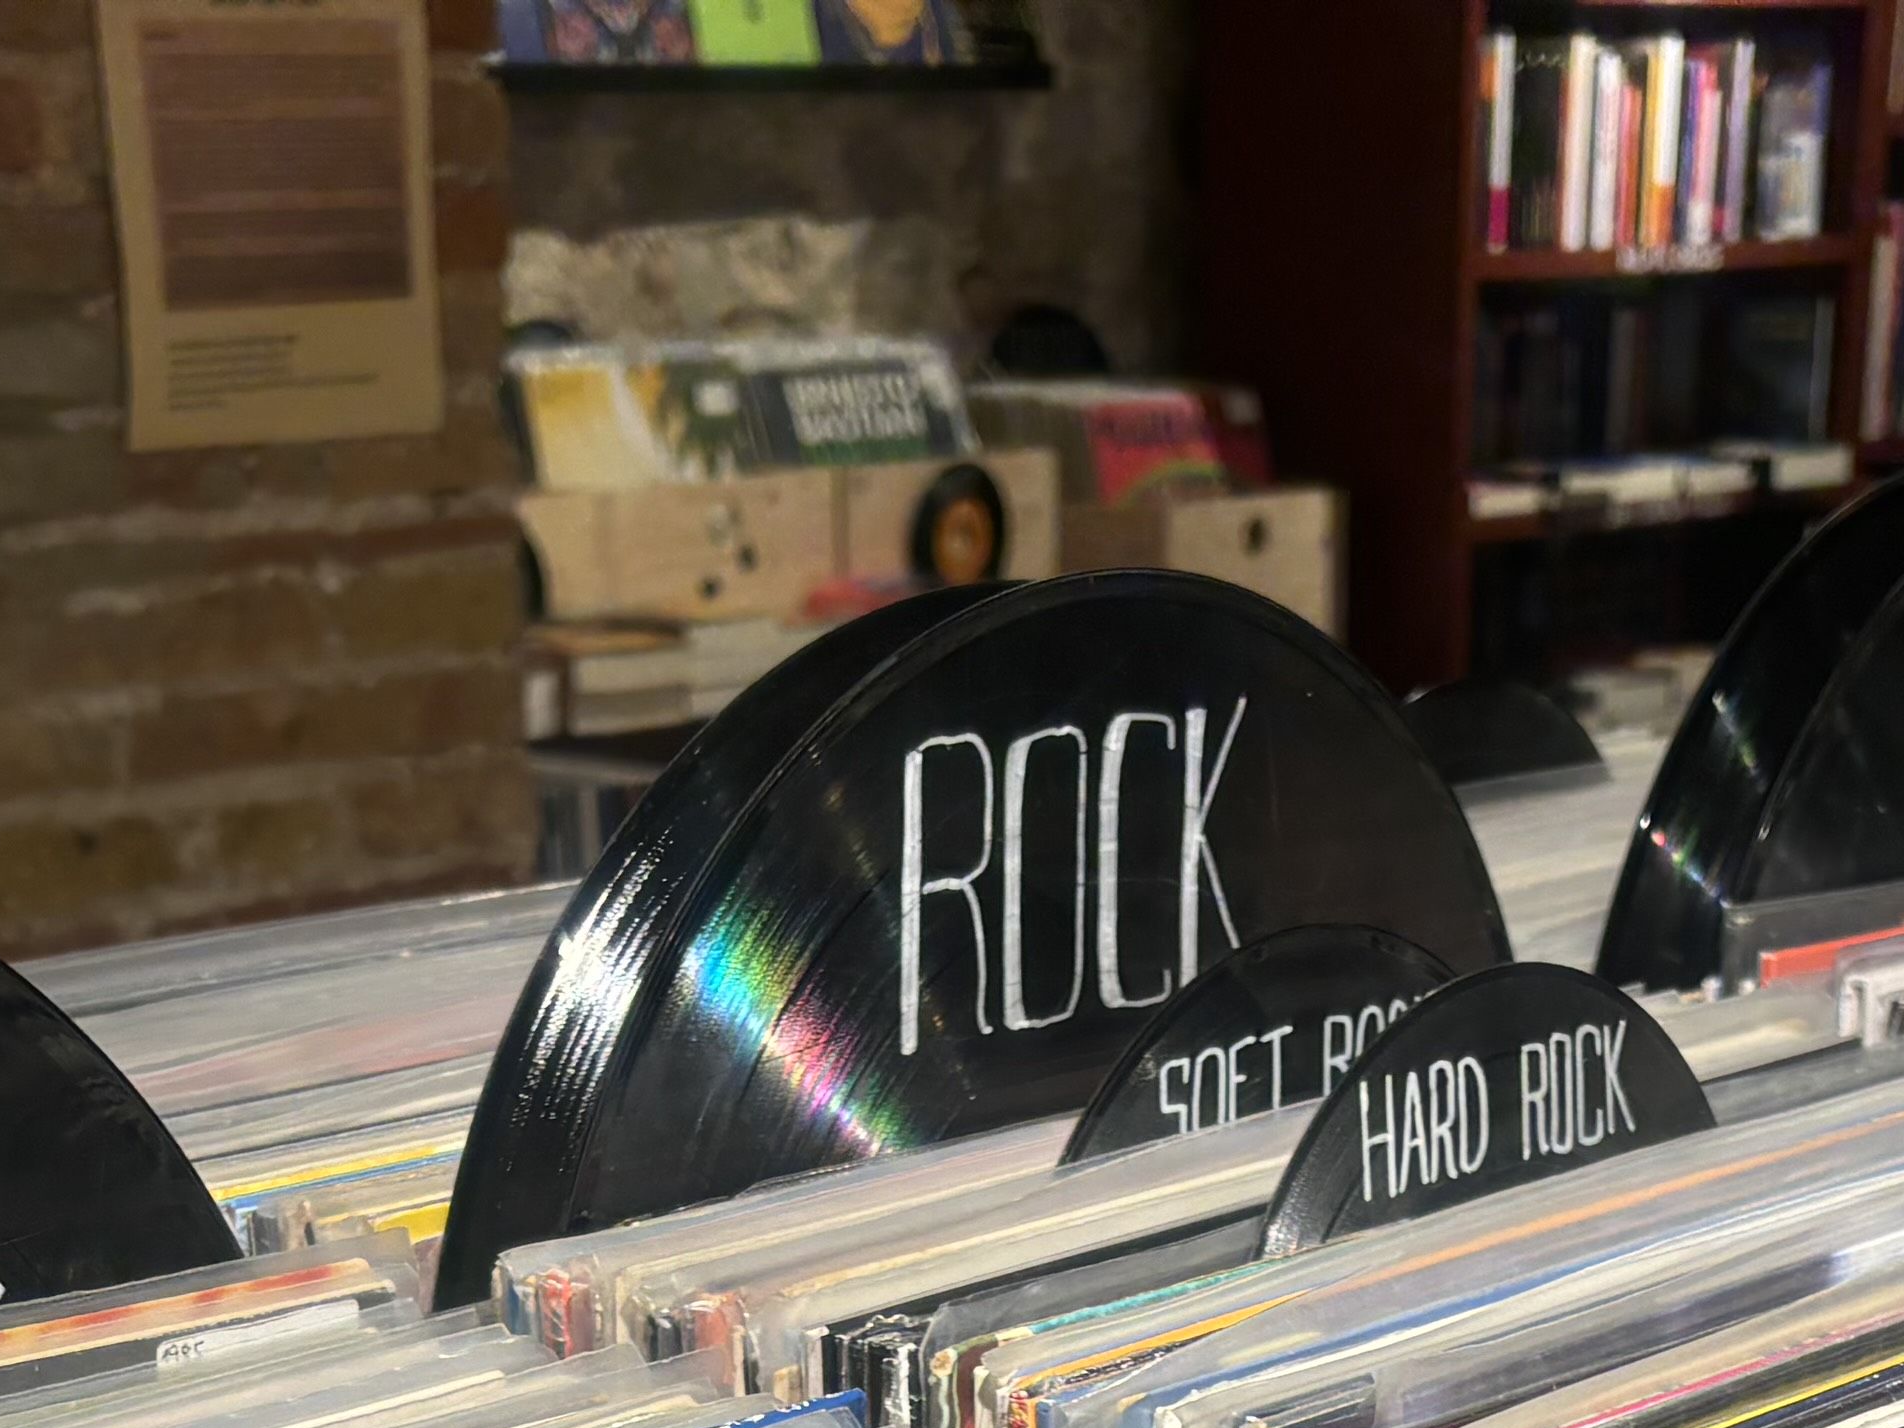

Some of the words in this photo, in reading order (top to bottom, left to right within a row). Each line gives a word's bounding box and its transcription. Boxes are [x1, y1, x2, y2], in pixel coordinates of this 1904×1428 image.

[900, 693, 1248, 1055] ROCK
[1158, 1024, 1294, 1135] SOFT
[1322, 988, 1440, 1098] RO
[1359, 1055, 1490, 1202] HARD
[1520, 1020, 1637, 1162] ROCK
